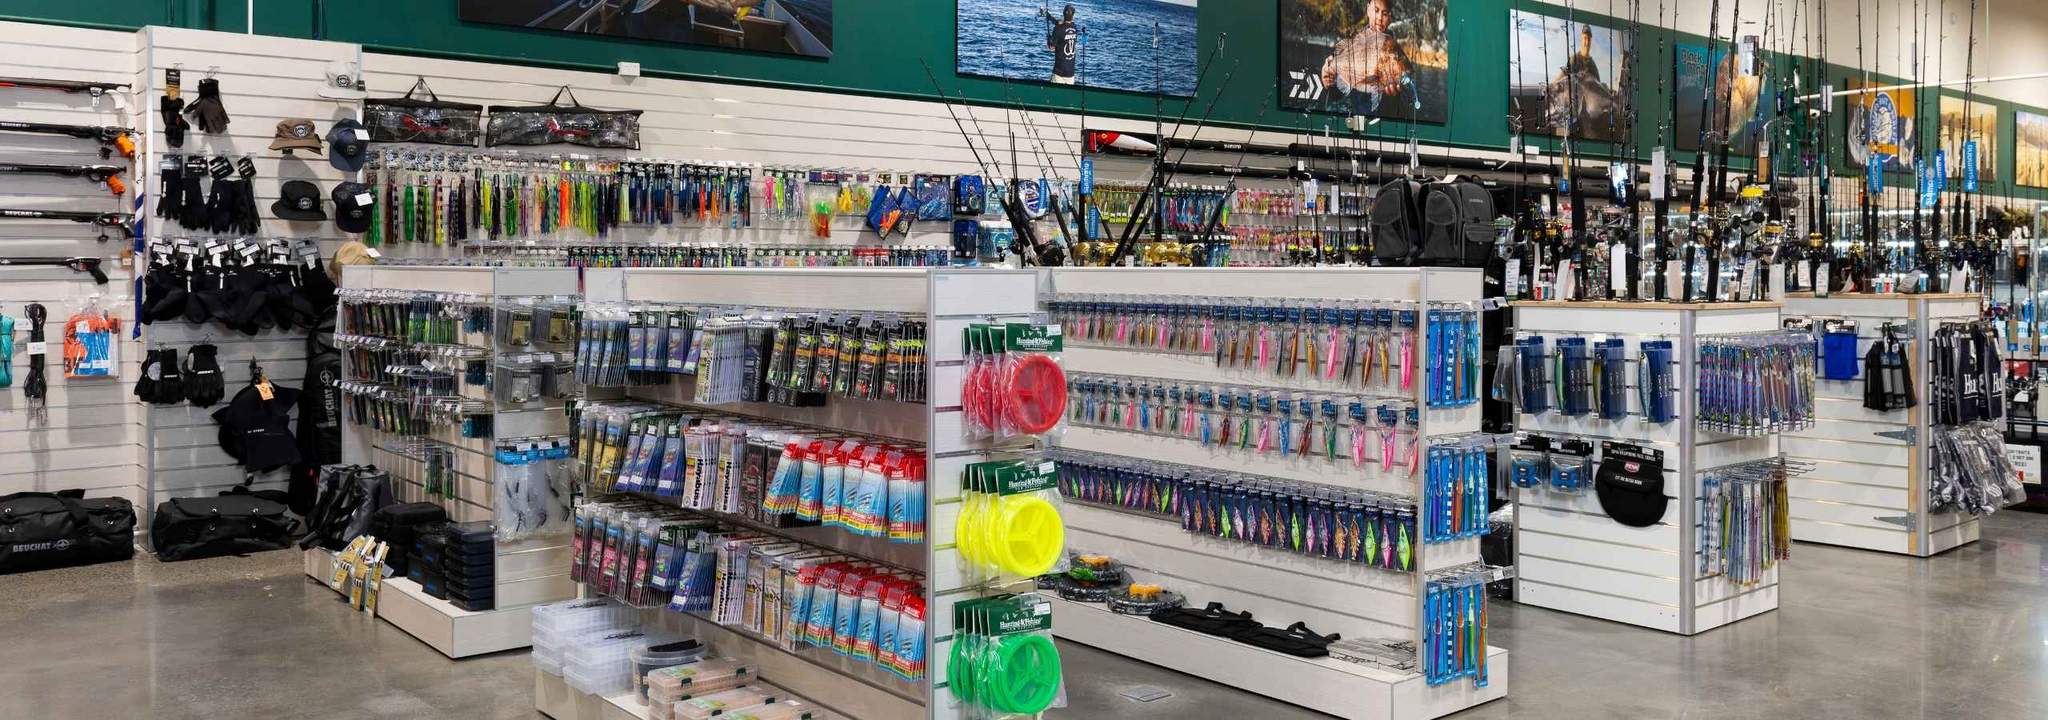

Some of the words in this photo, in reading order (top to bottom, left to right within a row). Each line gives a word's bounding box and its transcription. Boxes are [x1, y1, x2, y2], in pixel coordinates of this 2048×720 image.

[694, 459, 704, 507] Hayabusa
[723, 462, 733, 511] Hayabusa
[12, 541, 51, 553] BEUCHAT
